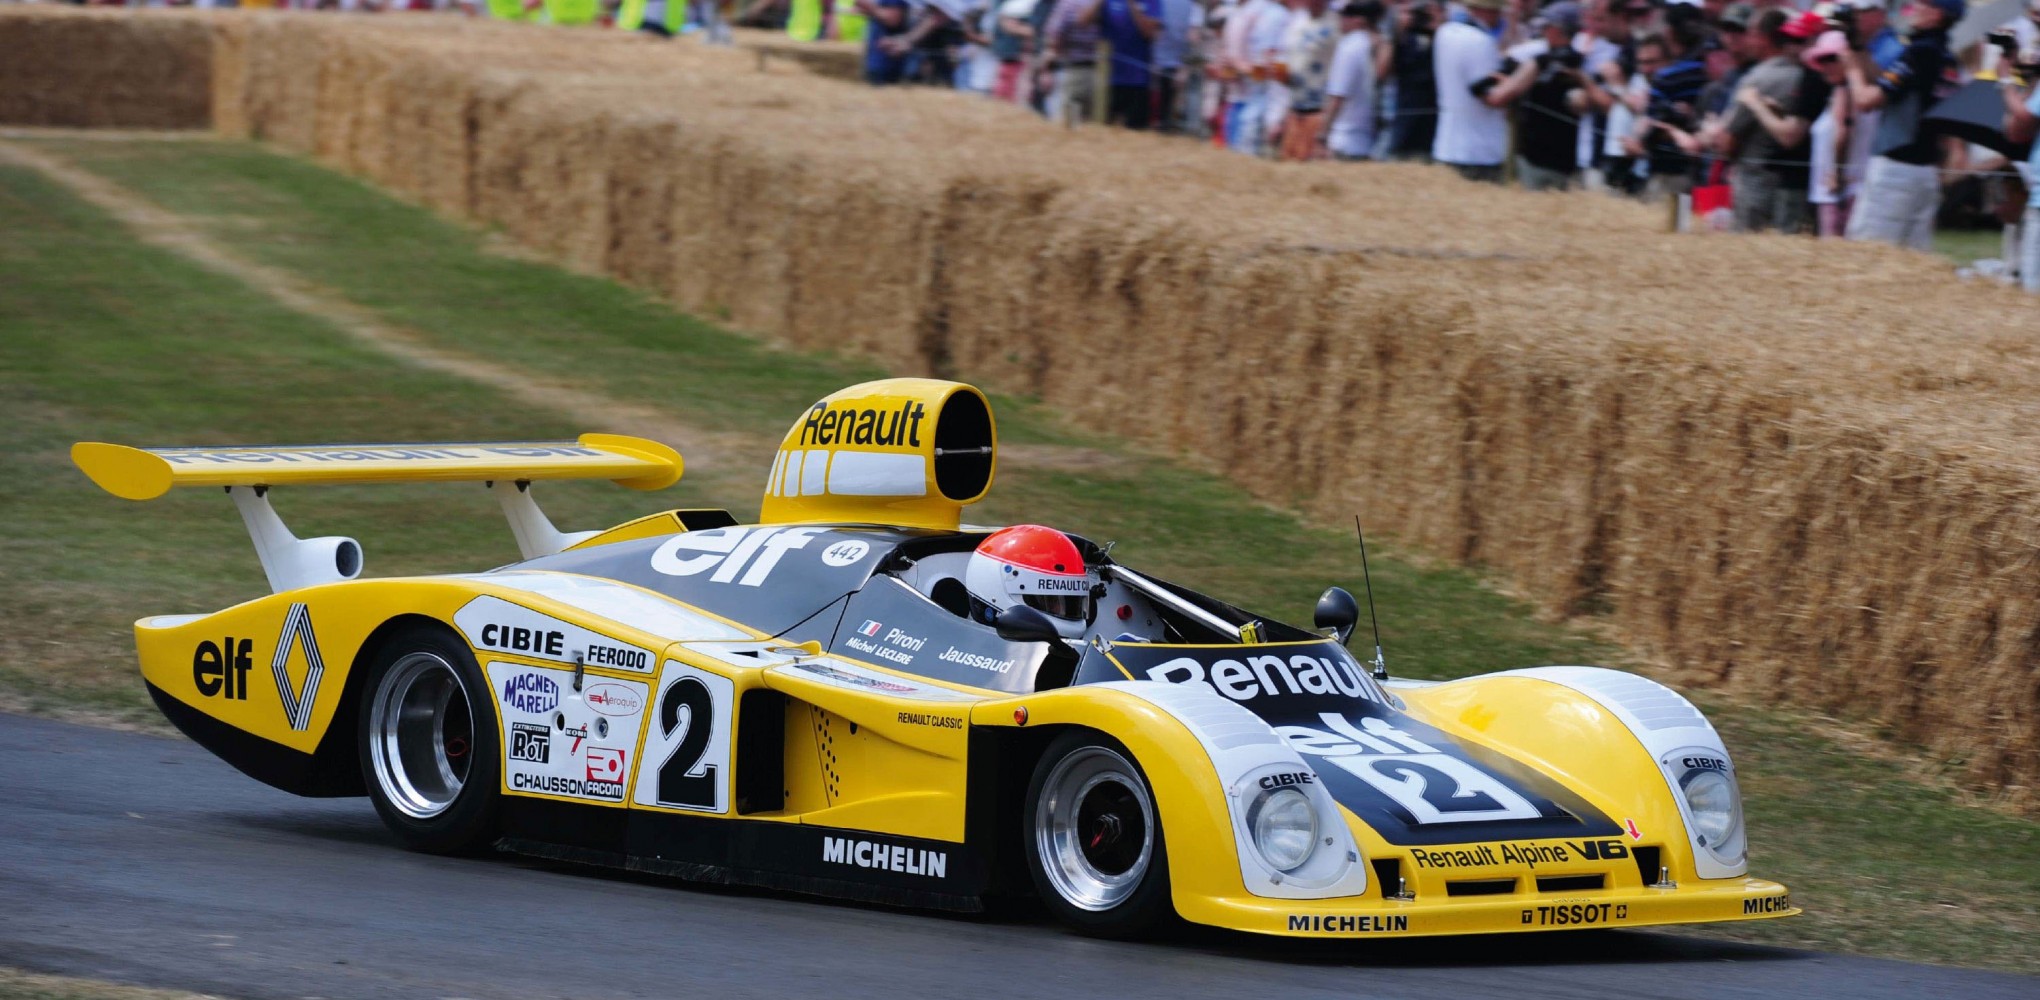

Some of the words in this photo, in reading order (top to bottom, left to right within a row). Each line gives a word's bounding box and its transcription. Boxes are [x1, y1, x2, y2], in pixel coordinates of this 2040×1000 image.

[800, 400, 925, 448] Renault
[650, 526, 832, 588] elf
[828, 542, 865, 562] 442
[1037, 578, 1081, 592] RENAULT
[588, 644, 647, 670] FERODO
[845, 636, 879, 654] Michel
[874, 646, 914, 666] LECLERE
[884, 627, 928, 652] Pironi
[938, 645, 1016, 674] Jaussaud
[193, 636, 253, 700] elf
[504, 672, 559, 700] MAGNETI
[602, 688, 638, 710] Aeroquip
[566, 728, 587, 738] KONI
[897, 711, 932, 726] RENAULT
[931, 715, 963, 730] CLASSIC
[1273, 712, 1442, 756] elf
[655, 674, 719, 811] 2
[513, 772, 587, 796] CHAUSSON
[587, 781, 623, 797] FACOM
[1368, 758, 1511, 814] 2
[822, 836, 947, 878] MICHELIN
[1409, 844, 1499, 868] Renault
[1501, 842, 1570, 869] Alpine
[1565, 839, 1629, 861] V6
[1287, 914, 1409, 932] MICHELIN
[1537, 903, 1612, 925] TISSOT
